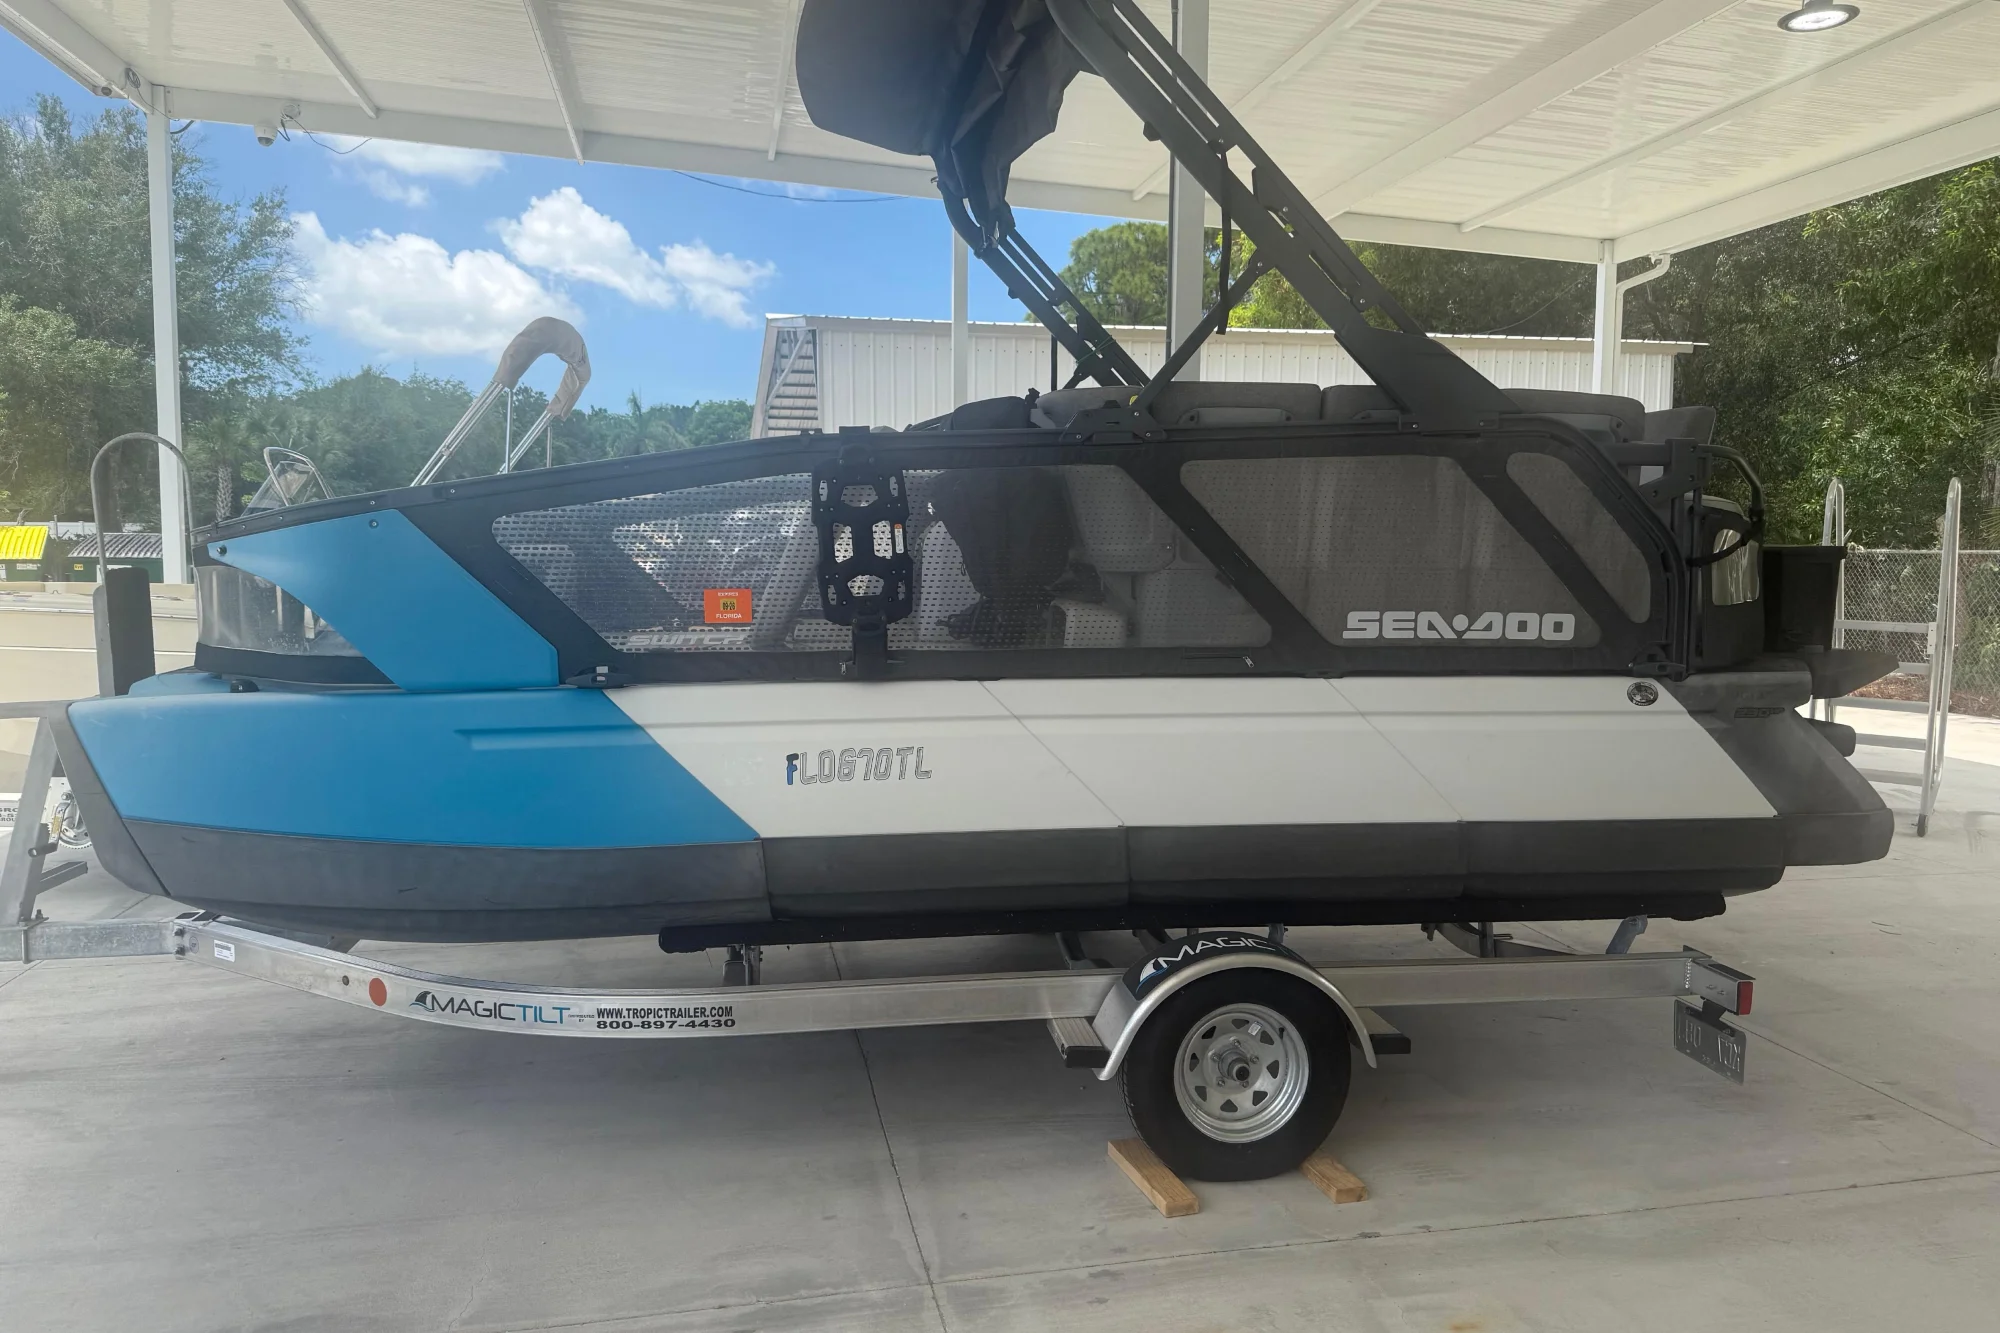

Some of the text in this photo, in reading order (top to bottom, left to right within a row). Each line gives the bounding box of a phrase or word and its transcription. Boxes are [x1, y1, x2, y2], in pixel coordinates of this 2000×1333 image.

[431, 994, 571, 1024] MAGICTILT
[596, 1006, 733, 1019] WWW.TROPICTRAILER.COM
[596, 1018, 736, 1029] 800-897-4430
